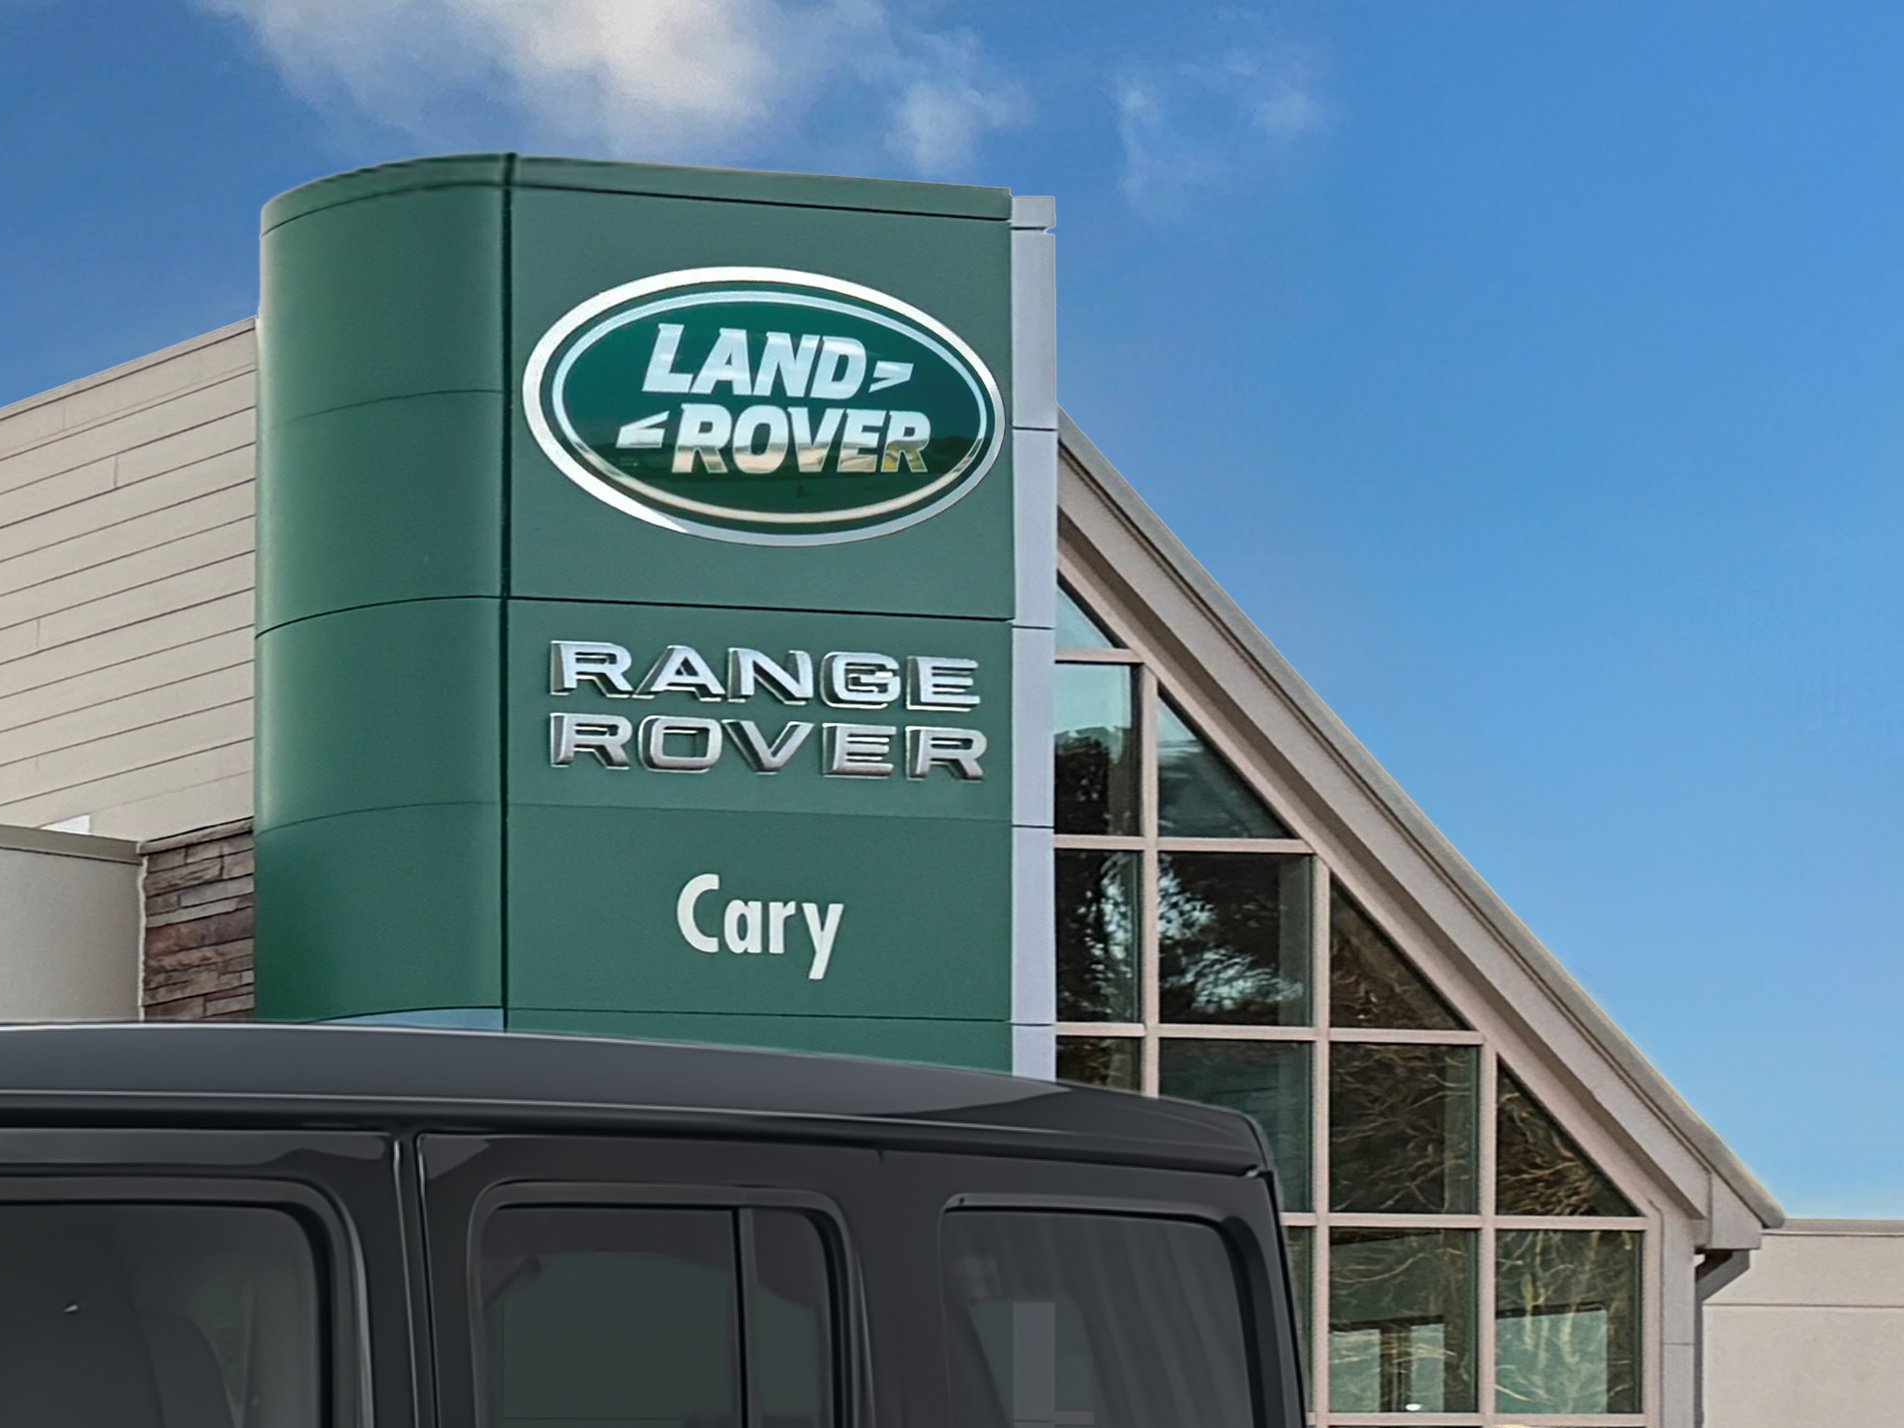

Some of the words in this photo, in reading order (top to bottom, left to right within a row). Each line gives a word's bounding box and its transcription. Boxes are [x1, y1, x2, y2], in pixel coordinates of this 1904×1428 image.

[641, 322, 871, 402] LAND
[669, 403, 932, 475] ROVER
[549, 639, 982, 712] RANGE
[549, 711, 988, 782] ROVER
[675, 872, 845, 981] Cary
